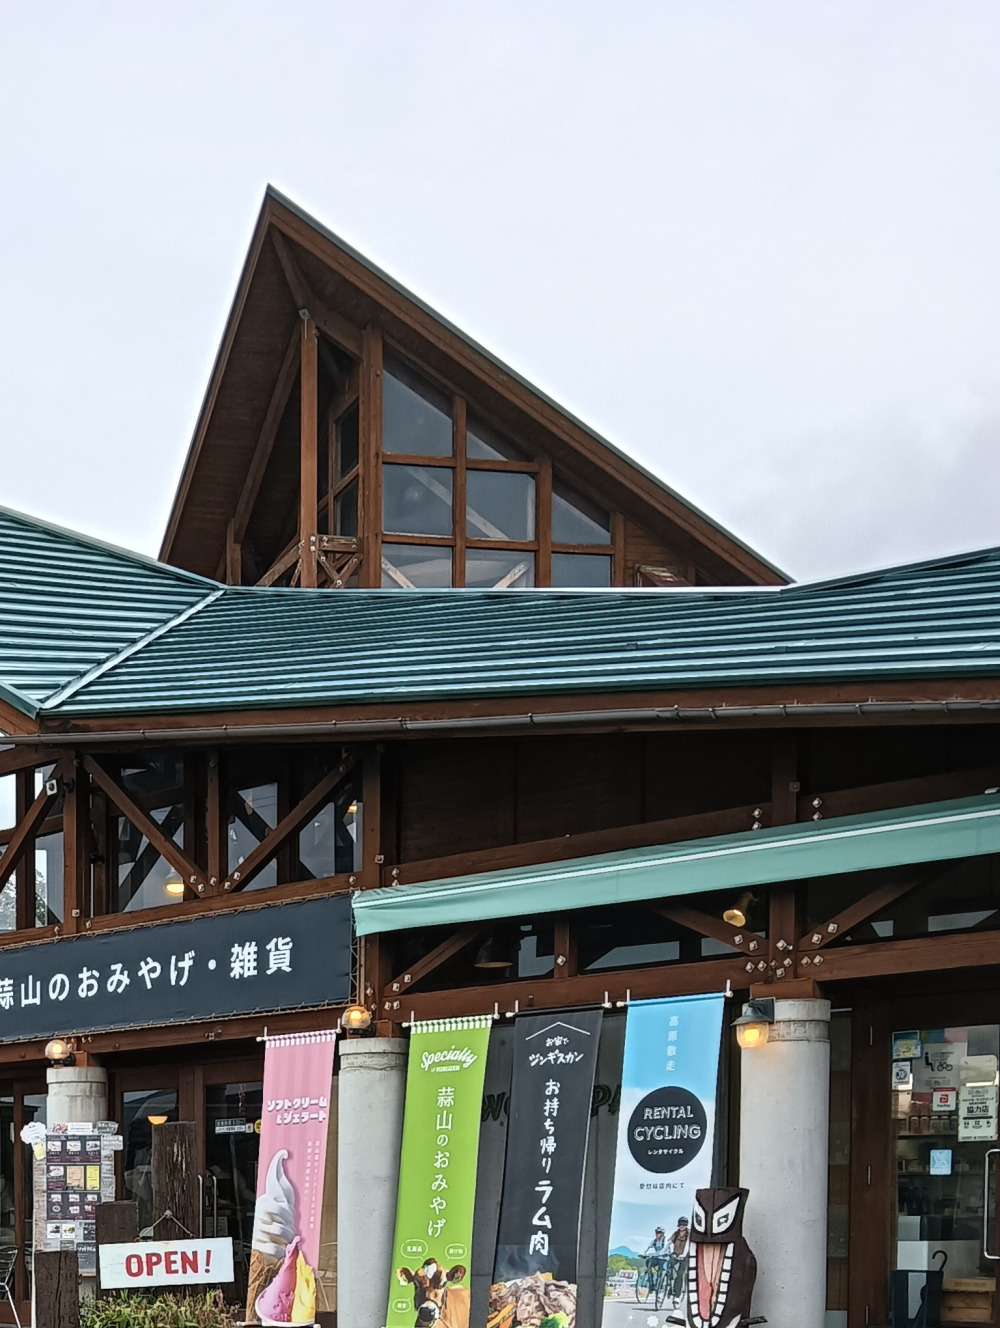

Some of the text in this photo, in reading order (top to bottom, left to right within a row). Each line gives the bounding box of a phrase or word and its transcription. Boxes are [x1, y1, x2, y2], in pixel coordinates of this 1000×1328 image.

[665, 1015, 679, 1072] 高原散走
[420, 1045, 478, 1072] Specialty
[267, 1096, 328, 1112] ソフトクリーム
[643, 1105, 694, 1121] RENTAL
[275, 1110, 327, 1126] &ジェラート
[633, 1123, 702, 1141] CYCLING
[647, 1148, 685, 1156] レンタサイクル
[427, 1086, 456, 1239] 蒜山のおみやげ
[125, 1249, 213, 1278] OPEN!
